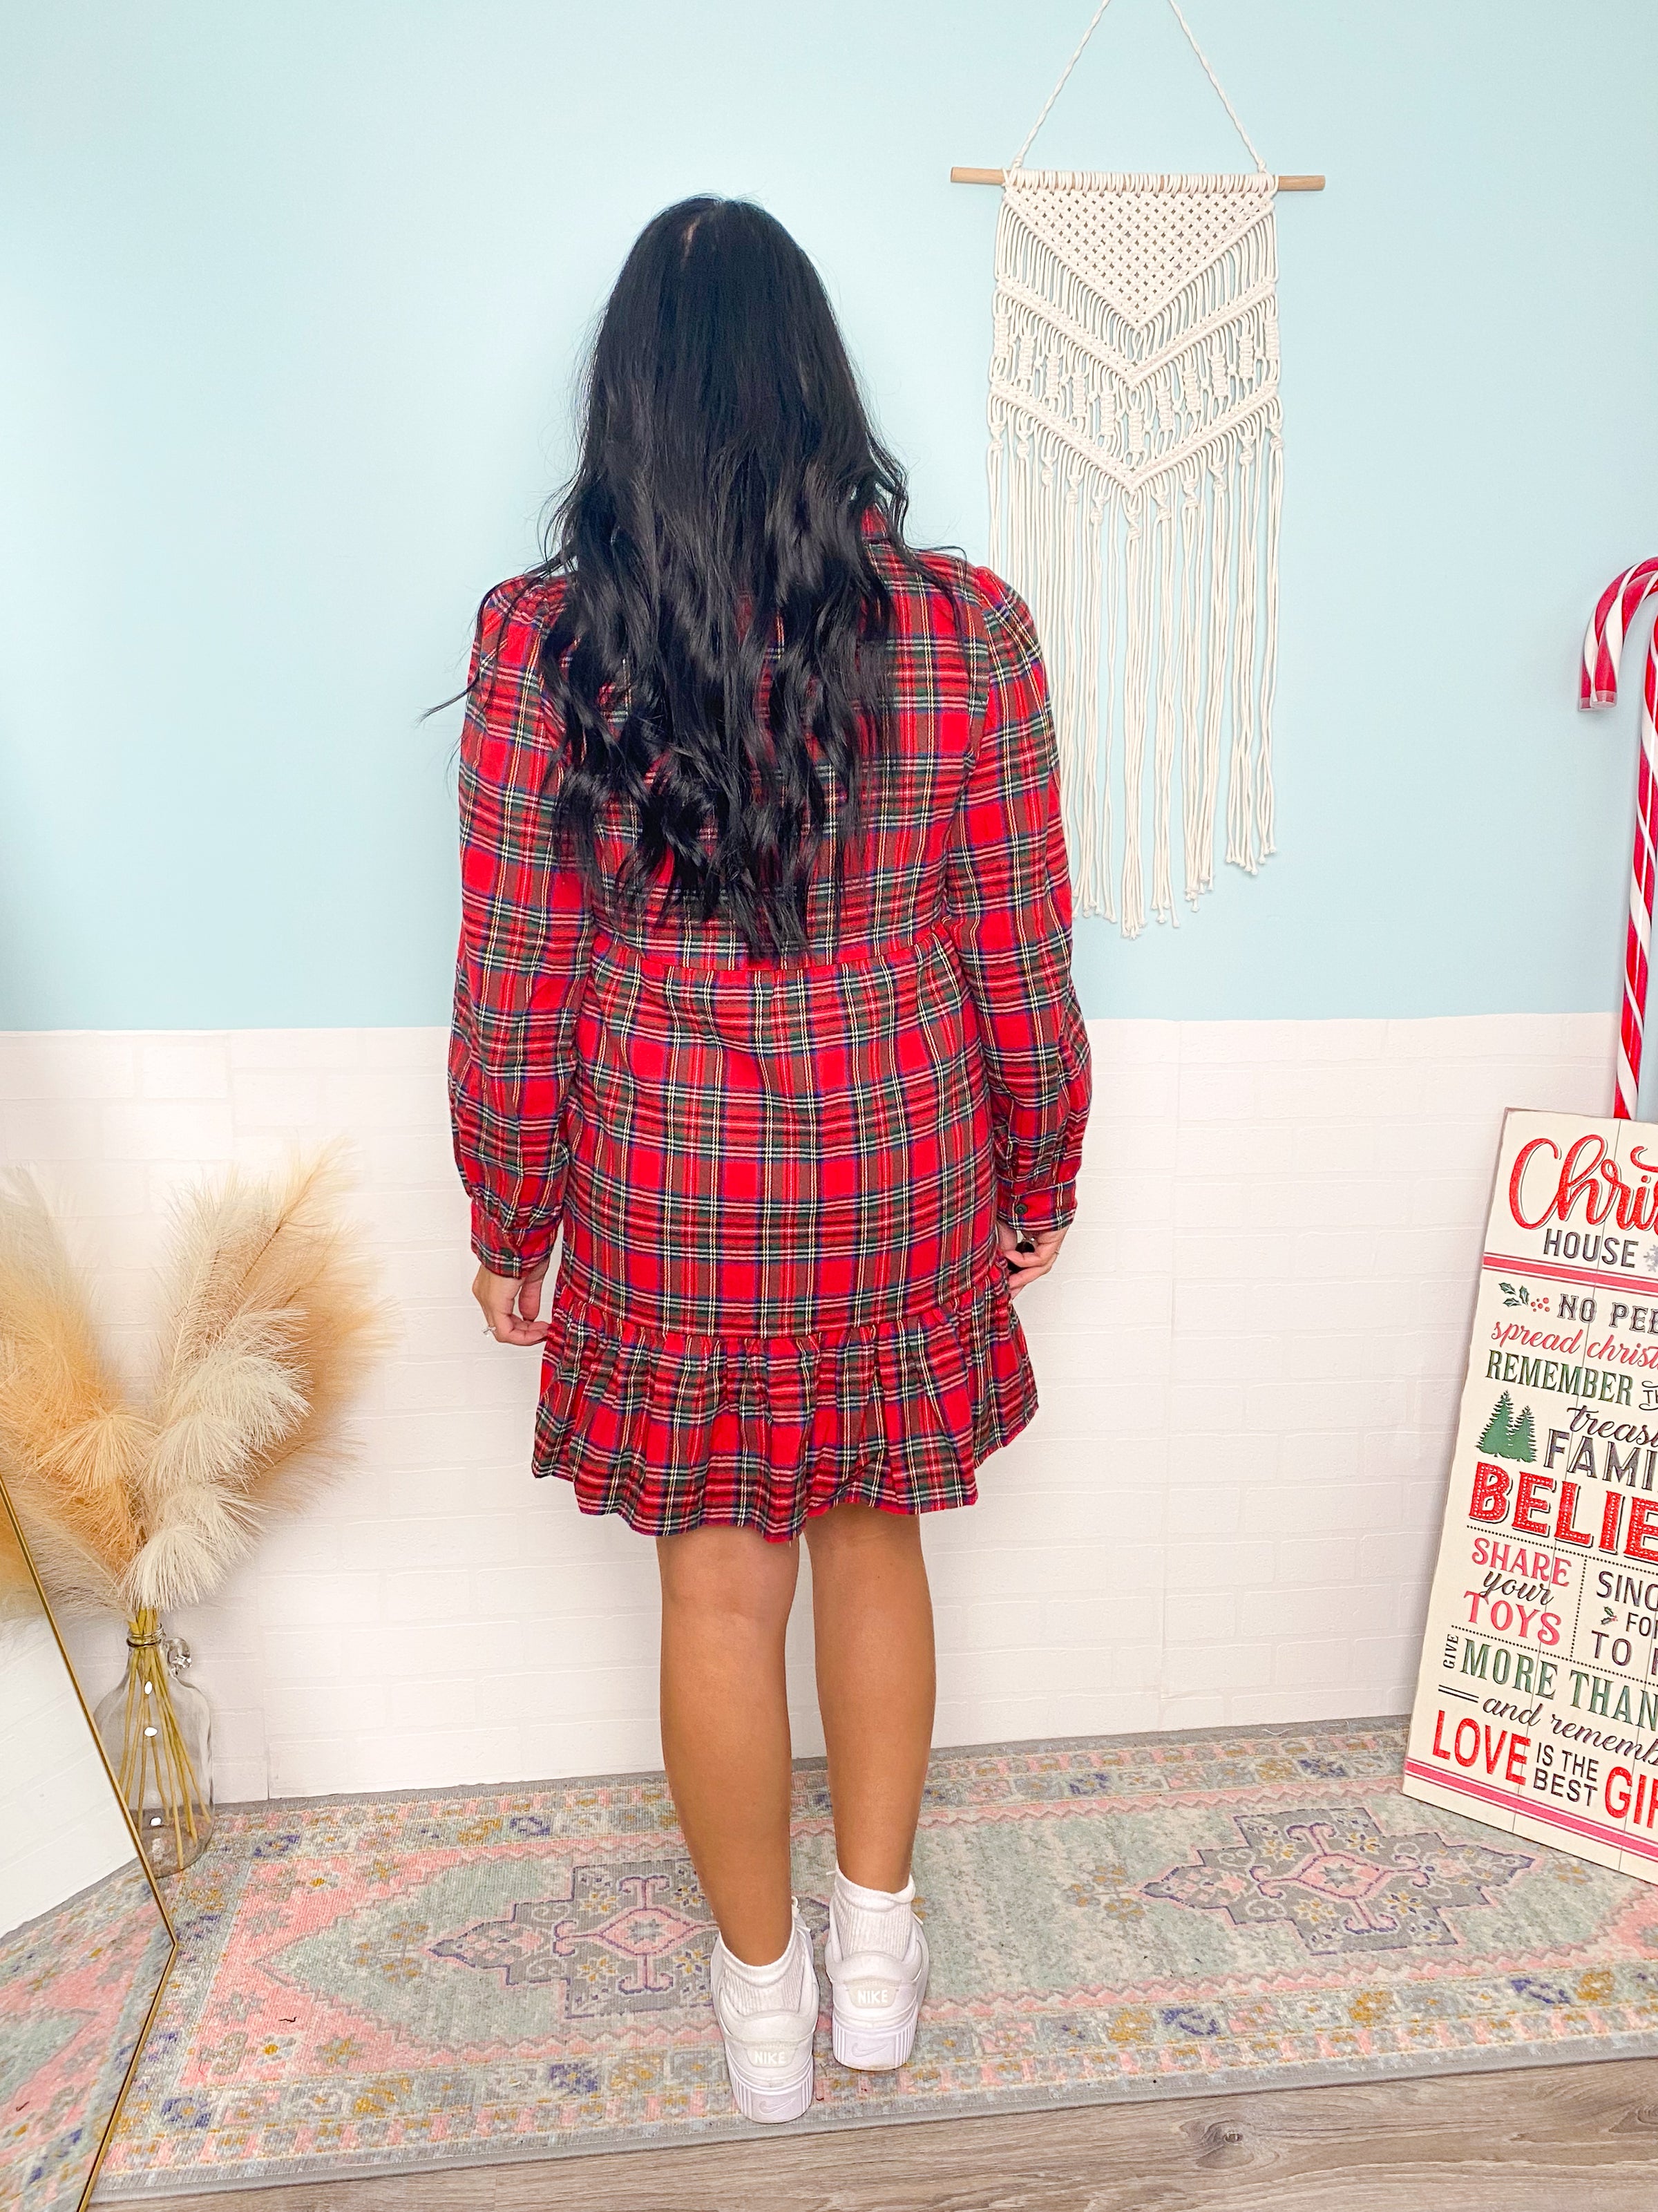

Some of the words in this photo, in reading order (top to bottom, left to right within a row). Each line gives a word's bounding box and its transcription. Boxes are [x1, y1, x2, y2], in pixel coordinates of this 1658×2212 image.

[1509, 1134, 1658, 1235] Chri
[1543, 1229, 1639, 1268] HOUSE
[1557, 1294, 1597, 1323] NO
[1491, 1321, 1583, 1354] spread
[1587, 1334, 1658, 1370] christ
[1485, 1349, 1634, 1406] REMEMBER
[1544, 1428, 1658, 1491] FAMI
[1469, 1462, 1658, 1565] BELIE
[1472, 1538, 1572, 1587] SHARE
[1478, 1571, 1554, 1605] your
[1463, 1591, 1561, 1645] TOYS
[1442, 1634, 1458, 1669] GIVE
[1592, 1630, 1632, 1665] TO
[1460, 1638, 1557, 1699] MORE
[1569, 1670, 1658, 1731] THAN
[1483, 1697, 1543, 1726] and
[1432, 1710, 1531, 1786] LOVE
[1536, 1742, 1554, 1766] IS
[1562, 1750, 1599, 1781] THE
[1533, 1767, 1598, 1806] BEST
[857, 1989, 888, 2004] NIKE
[754, 2051, 786, 2065] NIKE
